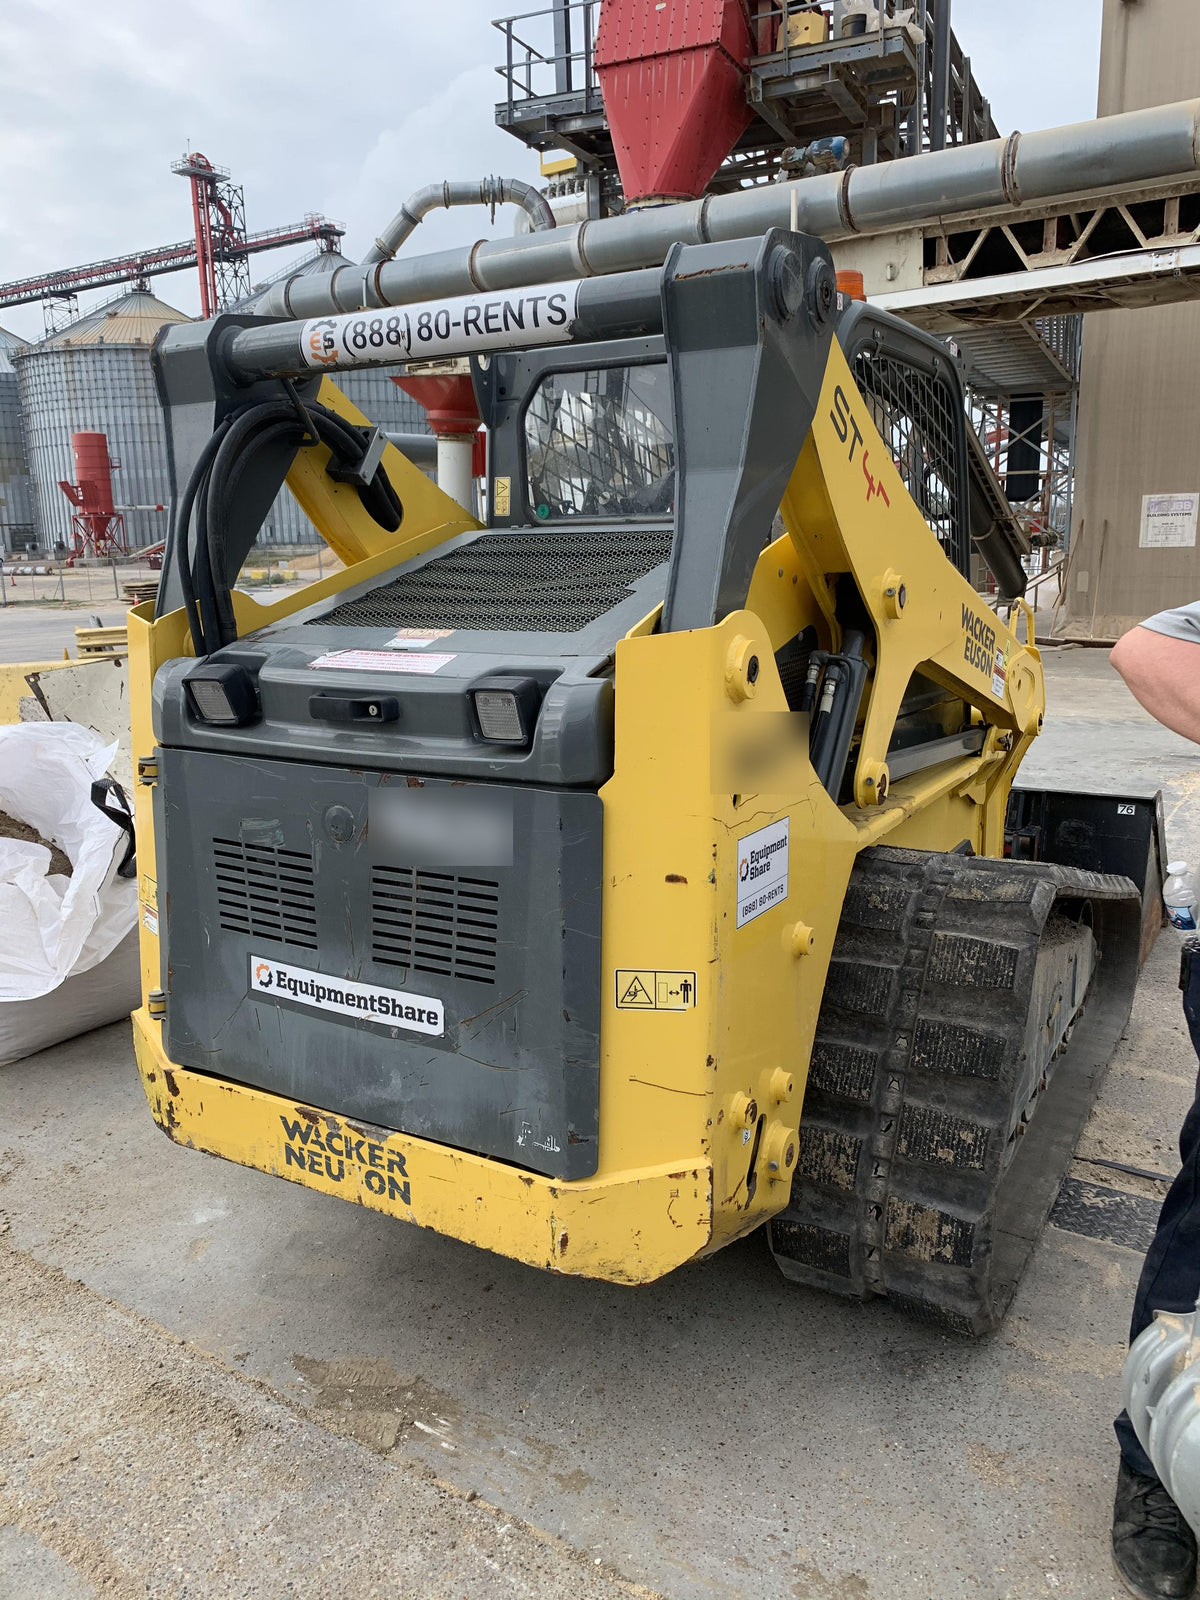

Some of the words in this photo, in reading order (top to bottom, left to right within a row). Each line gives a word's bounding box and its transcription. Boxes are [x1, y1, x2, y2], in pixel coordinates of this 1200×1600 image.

[342, 312, 412, 357] (888)
[416, 293, 567, 342] 80-RENTS
[961, 602, 996, 655] WACKER
[1119, 805, 1134, 814] 76
[749, 860, 771, 880] Share
[750, 834, 788, 865] Equipment
[742, 899, 758, 917] (888)
[758, 884, 784, 907] 80-RENTS
[275, 969, 439, 1026] EquipmentShare
[279, 1114, 409, 1178] WACKER
[283, 1143, 412, 1206] NEUON
